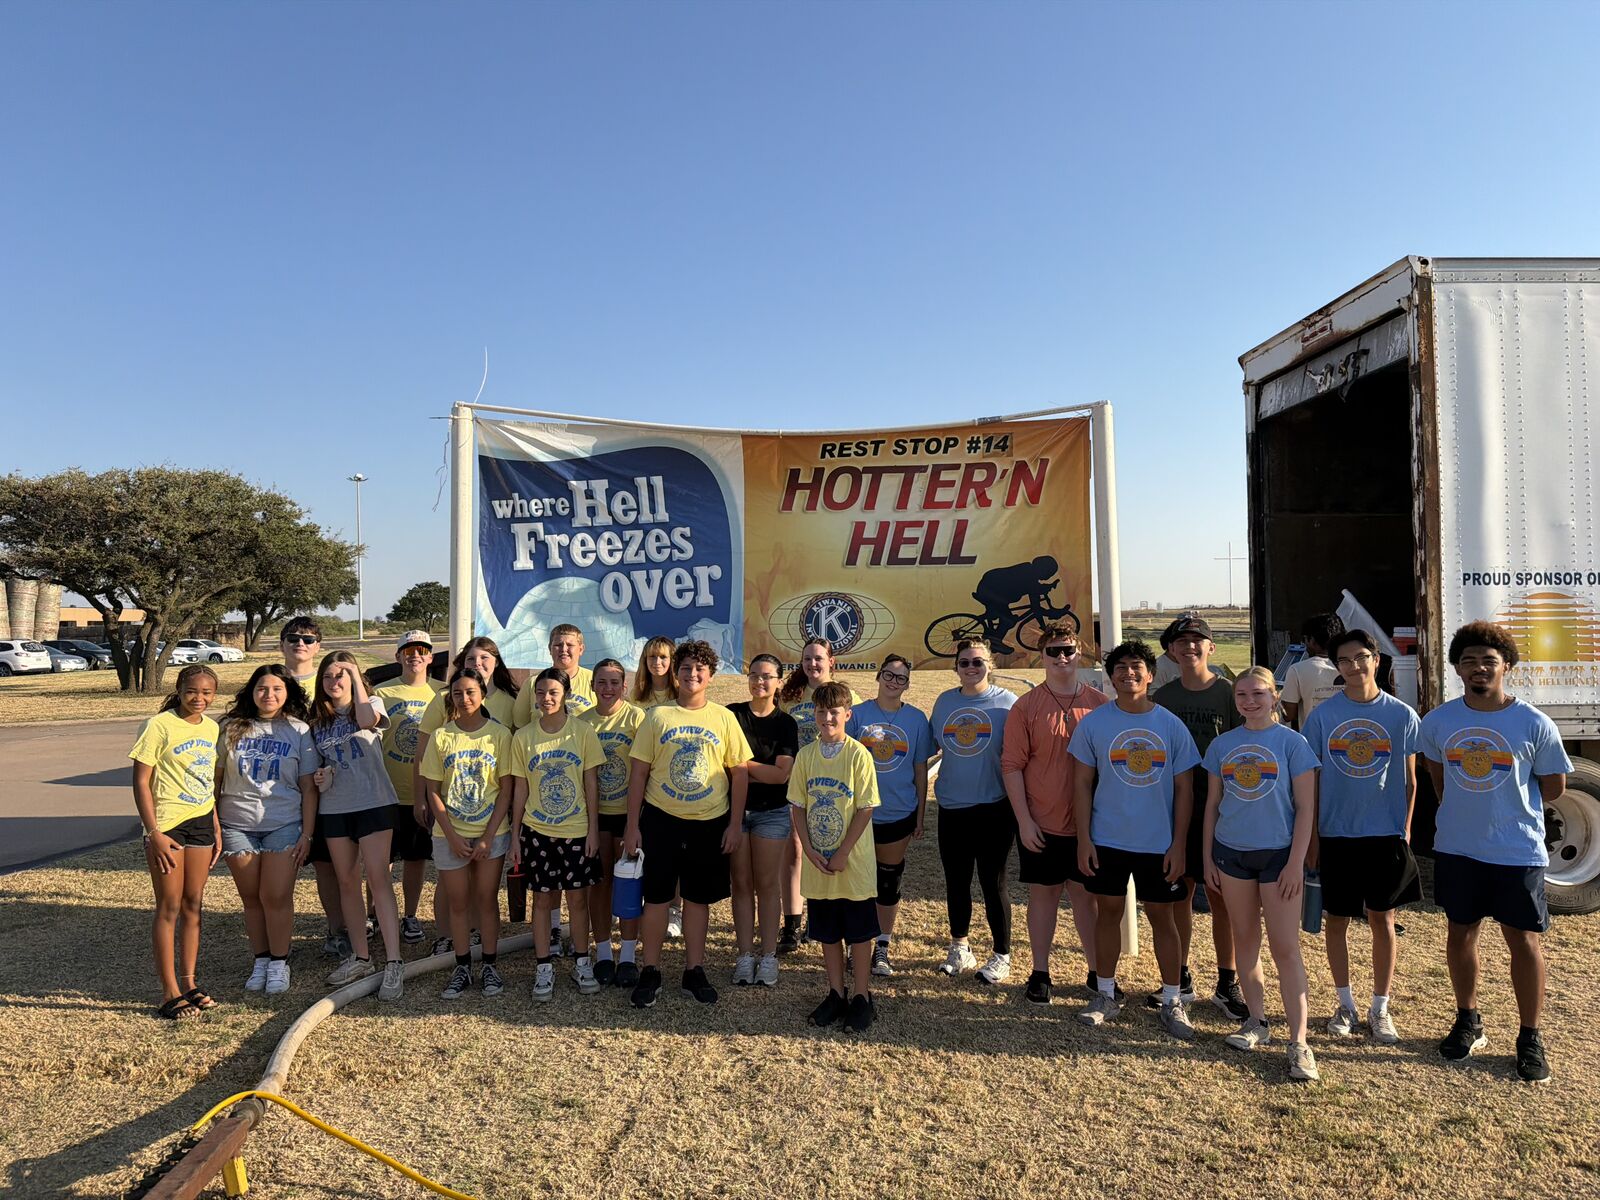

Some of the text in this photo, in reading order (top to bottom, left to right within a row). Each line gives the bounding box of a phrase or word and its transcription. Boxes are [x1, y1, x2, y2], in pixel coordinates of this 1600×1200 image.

[820, 434, 1010, 460] REST STOP #14
[780, 457, 1051, 514] HOTTER'N
[491, 475, 669, 528] where Hell
[510, 516, 695, 571] Freezes
[844, 518, 978, 568] HELL
[1462, 572, 1511, 586] PROUD
[1515, 571, 1583, 586] SPONSOR
[600, 564, 722, 614] over
[811, 598, 852, 613] KIWANIS
[819, 605, 847, 642] K
[833, 662, 877, 671] IWANIS
[1538, 677, 1561, 687] HELL
[403, 700, 427, 708] VIEW
[660, 726, 678, 744] CITY
[679, 725, 705, 735] VIEW
[173, 738, 195, 755] CITY
[261, 739, 292, 757] VIEW
[541, 749, 567, 760] VIEW
[815, 776, 839, 788] VIEW
[816, 814, 830, 823] FFA
